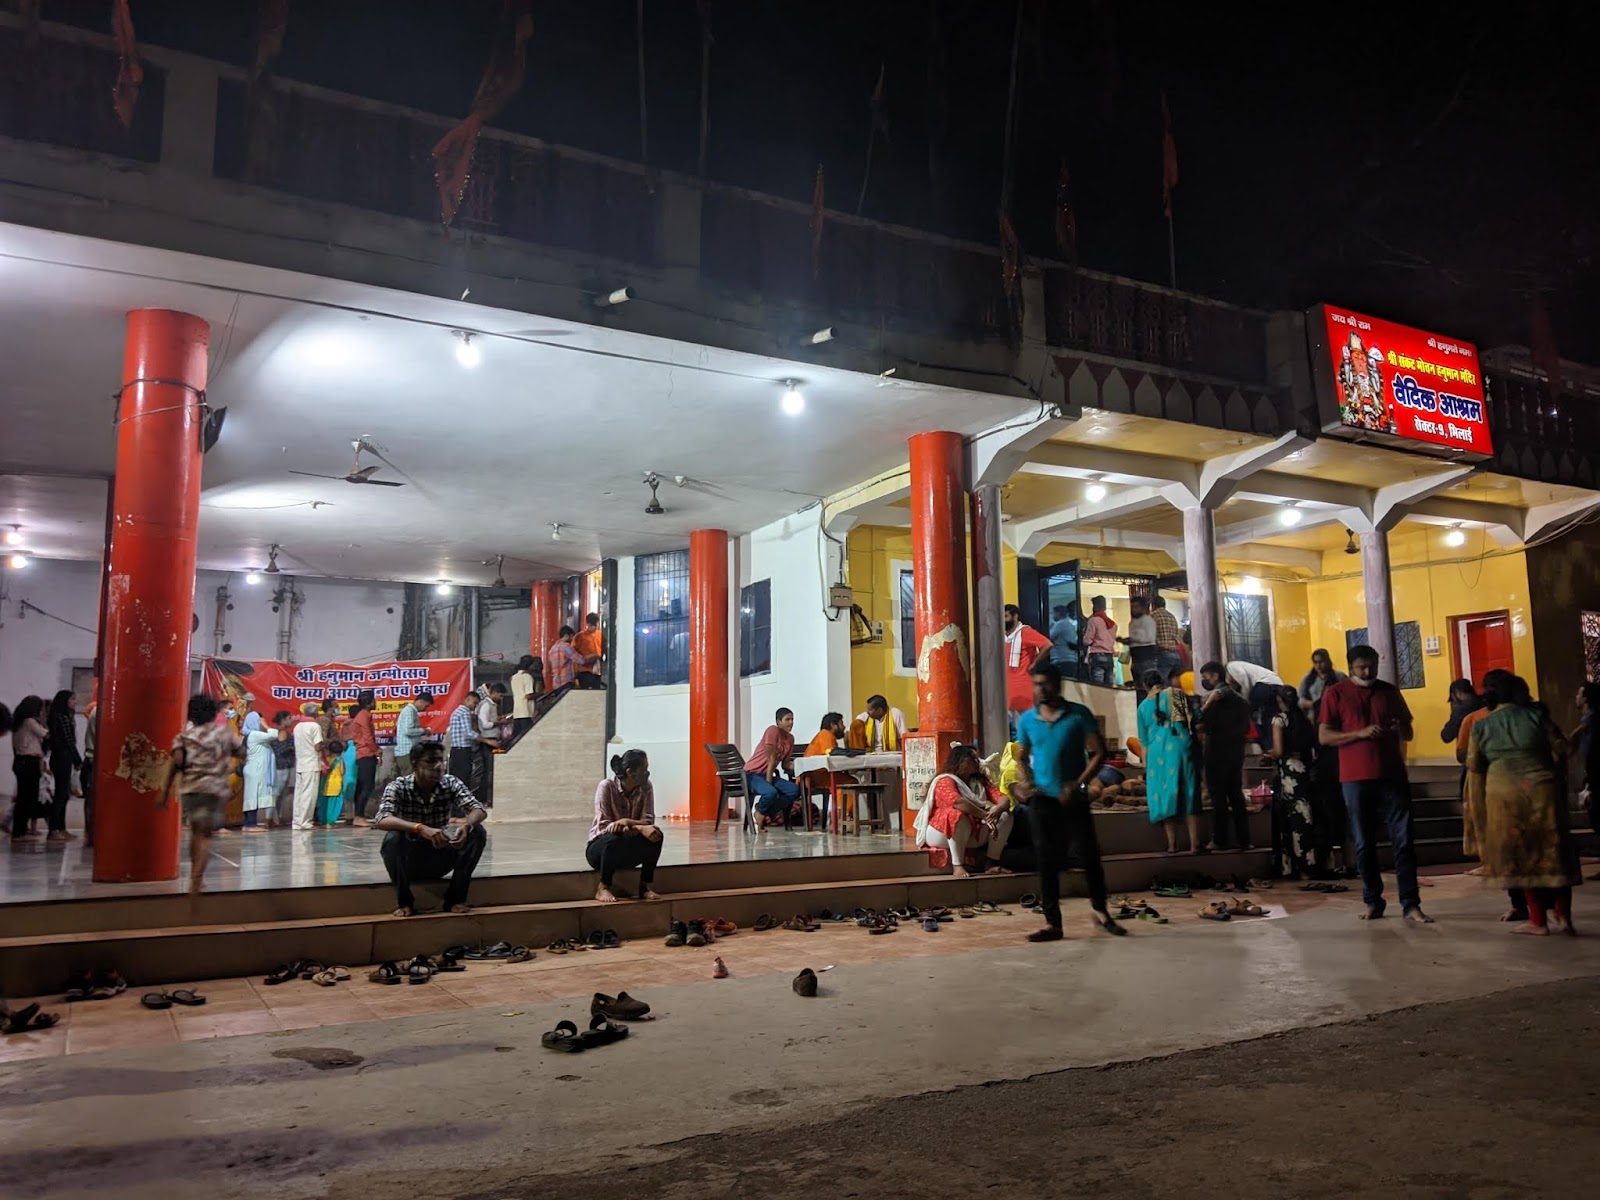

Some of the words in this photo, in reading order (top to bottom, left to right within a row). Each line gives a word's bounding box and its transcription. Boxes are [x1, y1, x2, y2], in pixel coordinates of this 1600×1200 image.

[1331, 313, 1346, 324] जय
[1347, 316, 1357, 328] श्री
[1358, 321, 1371, 331] राम
[1427, 337, 1436, 349] श्री
[1387, 351, 1398, 368] श्री
[1398, 354, 1416, 371] संकट
[1416, 357, 1436, 376] मोचन
[1436, 365, 1460, 383] हनुमान
[1459, 368, 1477, 386] मंदिर
[1392, 372, 1437, 412] वैदिक
[1438, 393, 1483, 423] आश्रम
[295, 668, 315, 683] श्री
[317, 669, 366, 685] हनुमान
[367, 664, 430, 681] जन्मोत्सव
[272, 686, 293, 699] का
[295, 686, 326, 700] भव्य
[327, 685, 387, 700] आयोन
[389, 683, 410, 698] एवं
